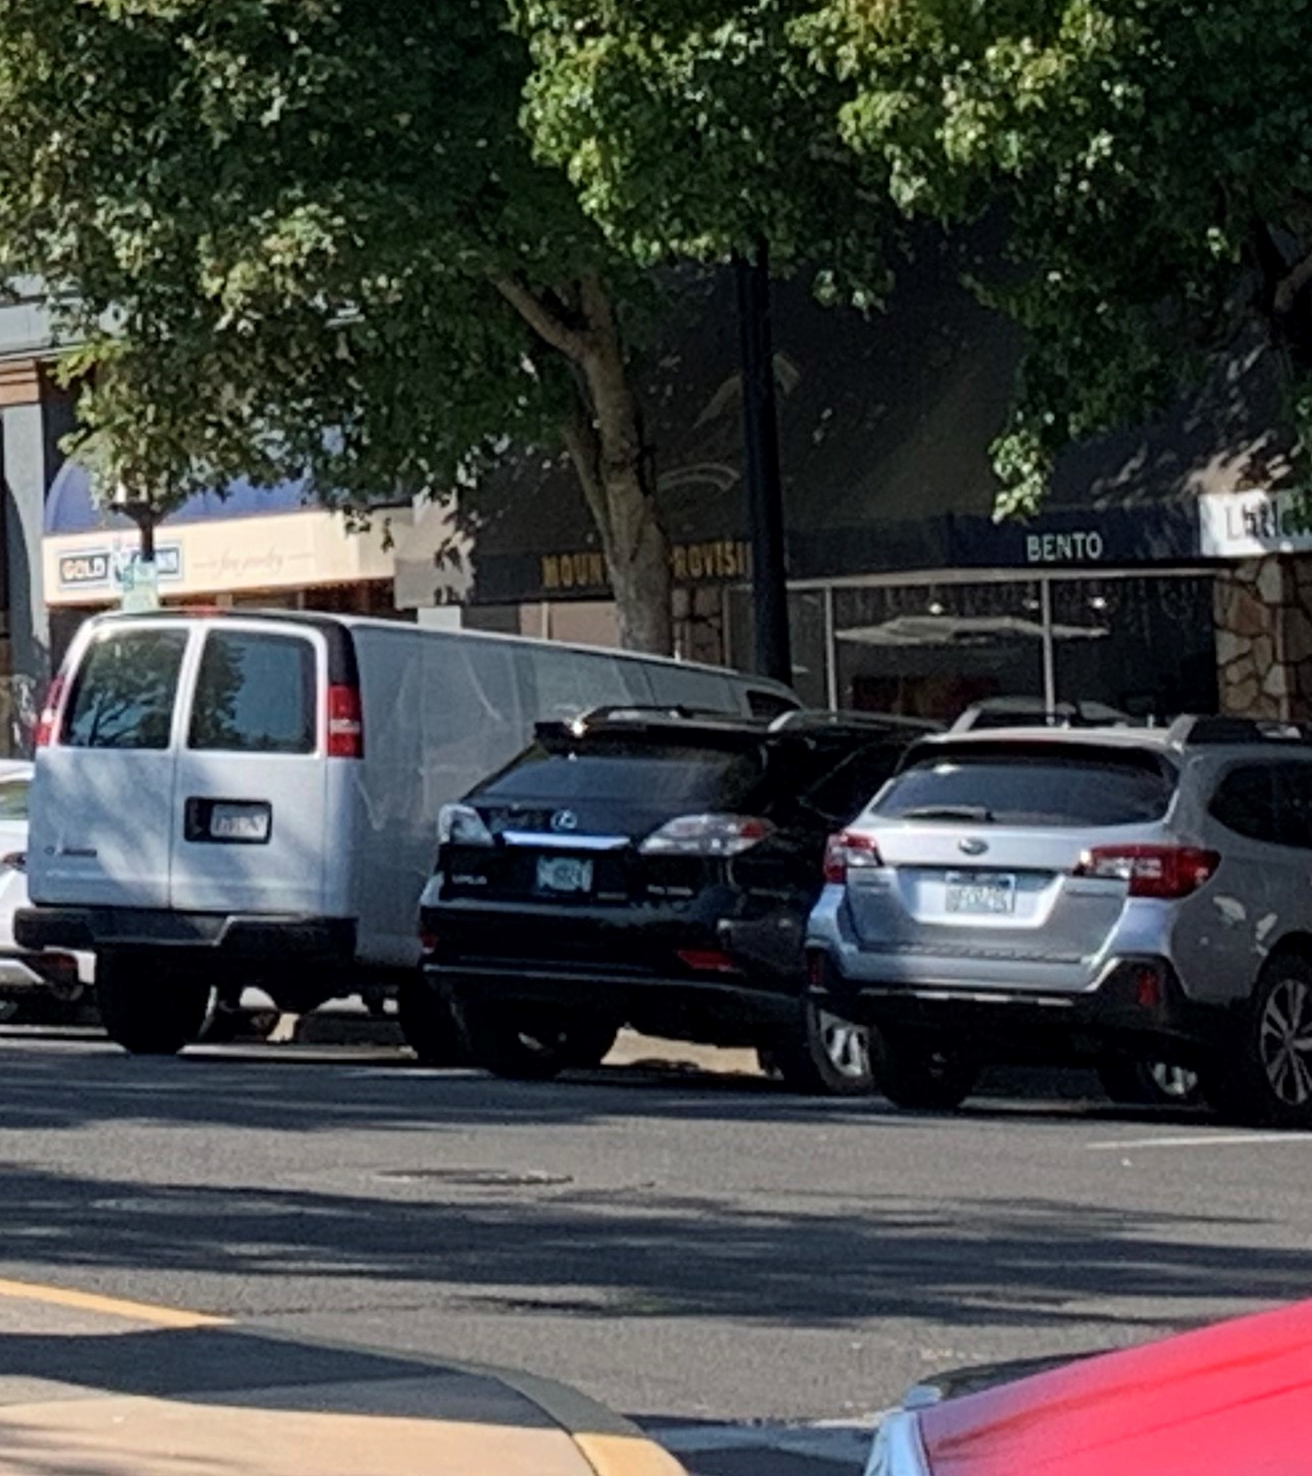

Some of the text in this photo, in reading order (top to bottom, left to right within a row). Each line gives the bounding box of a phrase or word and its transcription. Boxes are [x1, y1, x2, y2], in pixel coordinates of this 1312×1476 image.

[1027, 532, 1103, 561] BENTO
[63, 558, 106, 581] GOLD
[541, 541, 753, 589] MOUN ROVISI
